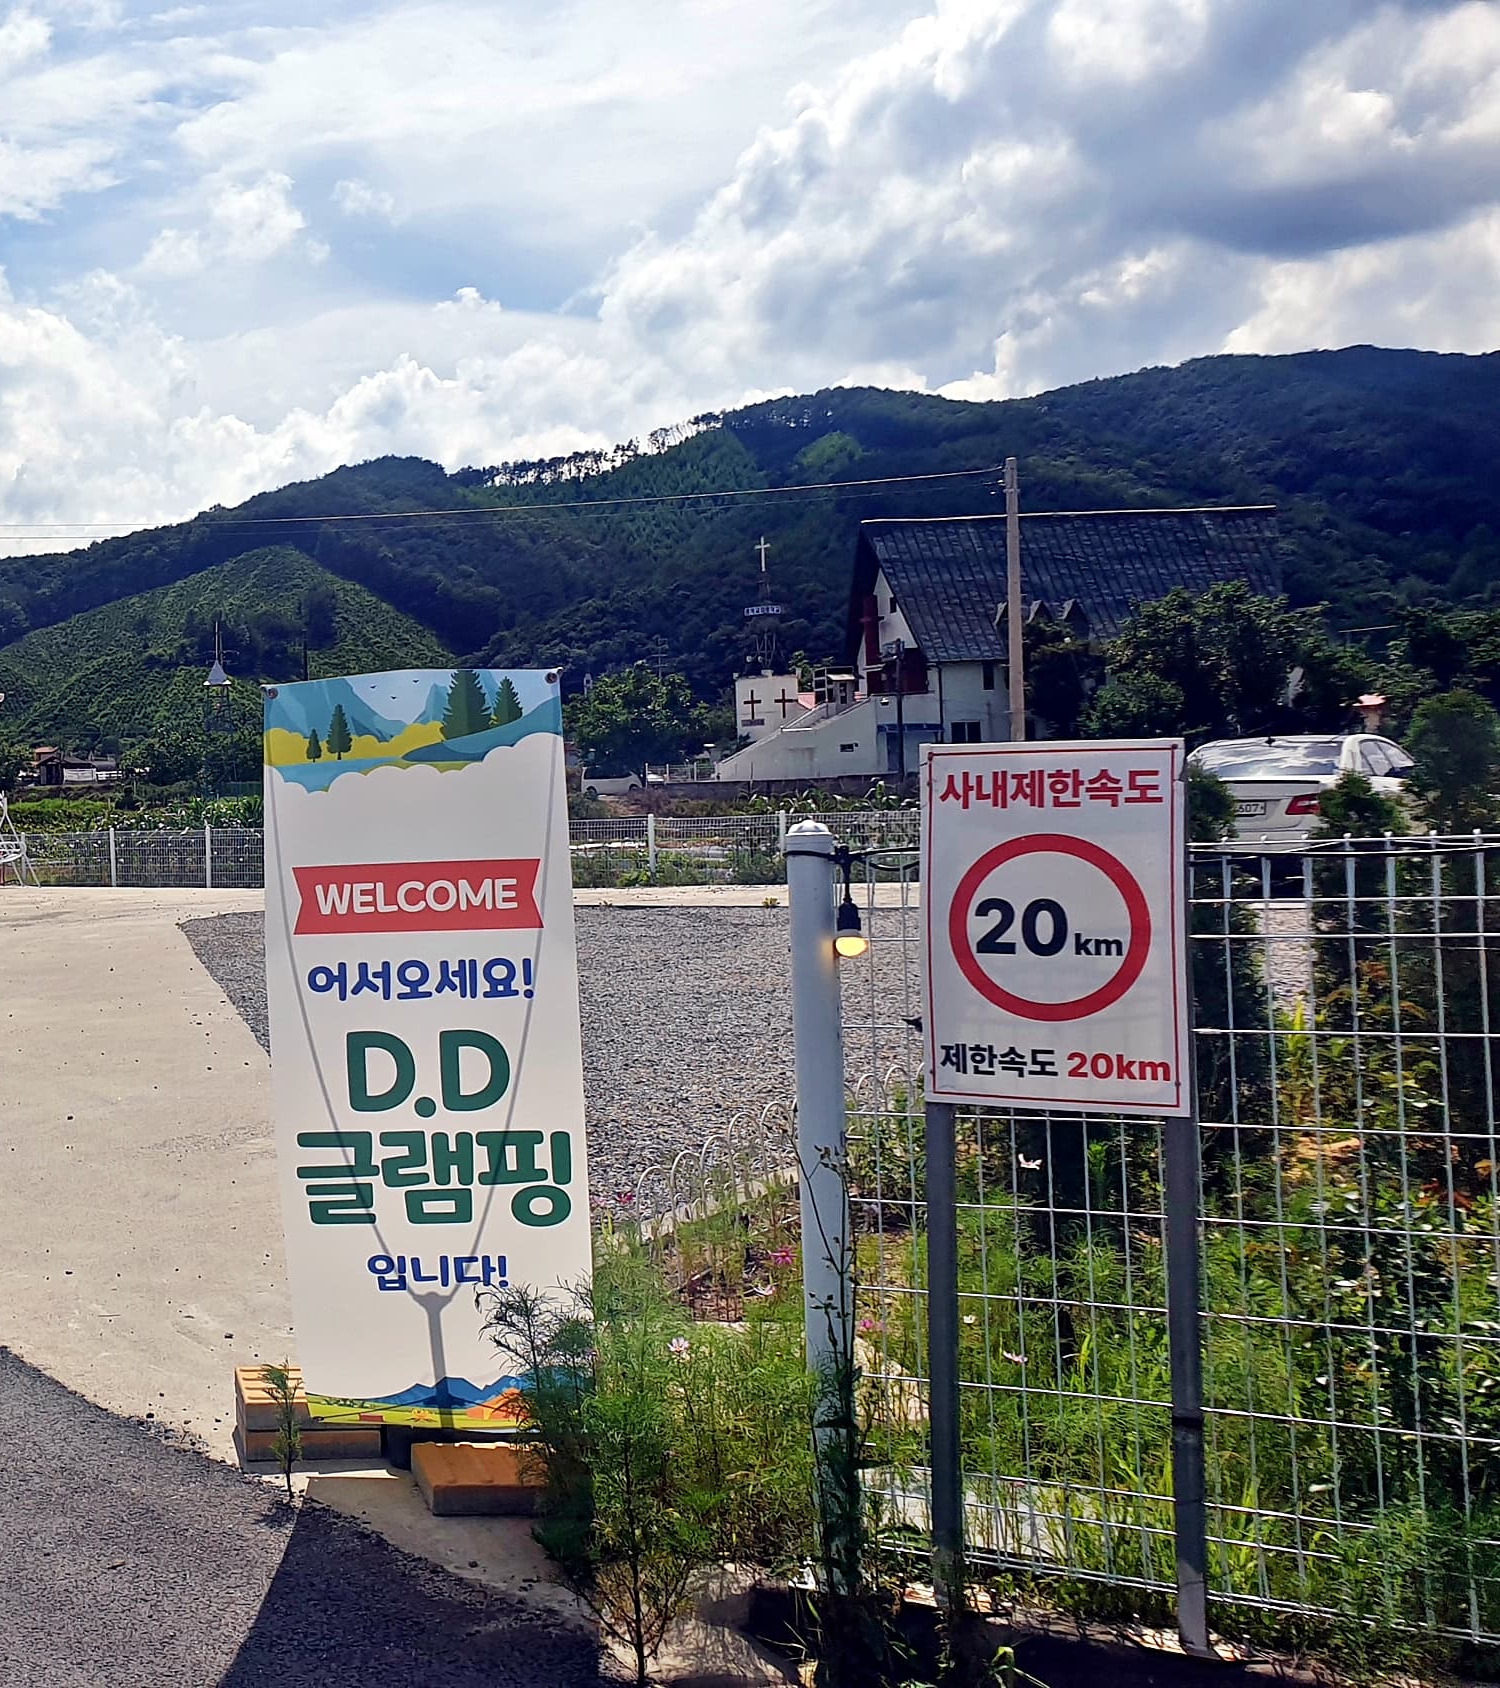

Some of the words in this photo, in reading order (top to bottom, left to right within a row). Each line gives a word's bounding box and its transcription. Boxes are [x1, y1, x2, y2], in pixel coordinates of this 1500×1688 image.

[940, 769, 1164, 809] 사내제한속도
[315, 878, 519, 917] WELCOME
[974, 898, 1068, 957] 20
[1074, 933, 1123, 957] km
[307, 957, 535, 1003] 어서오세요!
[346, 1029, 511, 1119] D.D
[940, 1044, 1059, 1077] 제한속도
[1066, 1052, 1171, 1082] 20km
[296, 1130, 573, 1227] 글램핑
[367, 1254, 508, 1292] 입니다!
